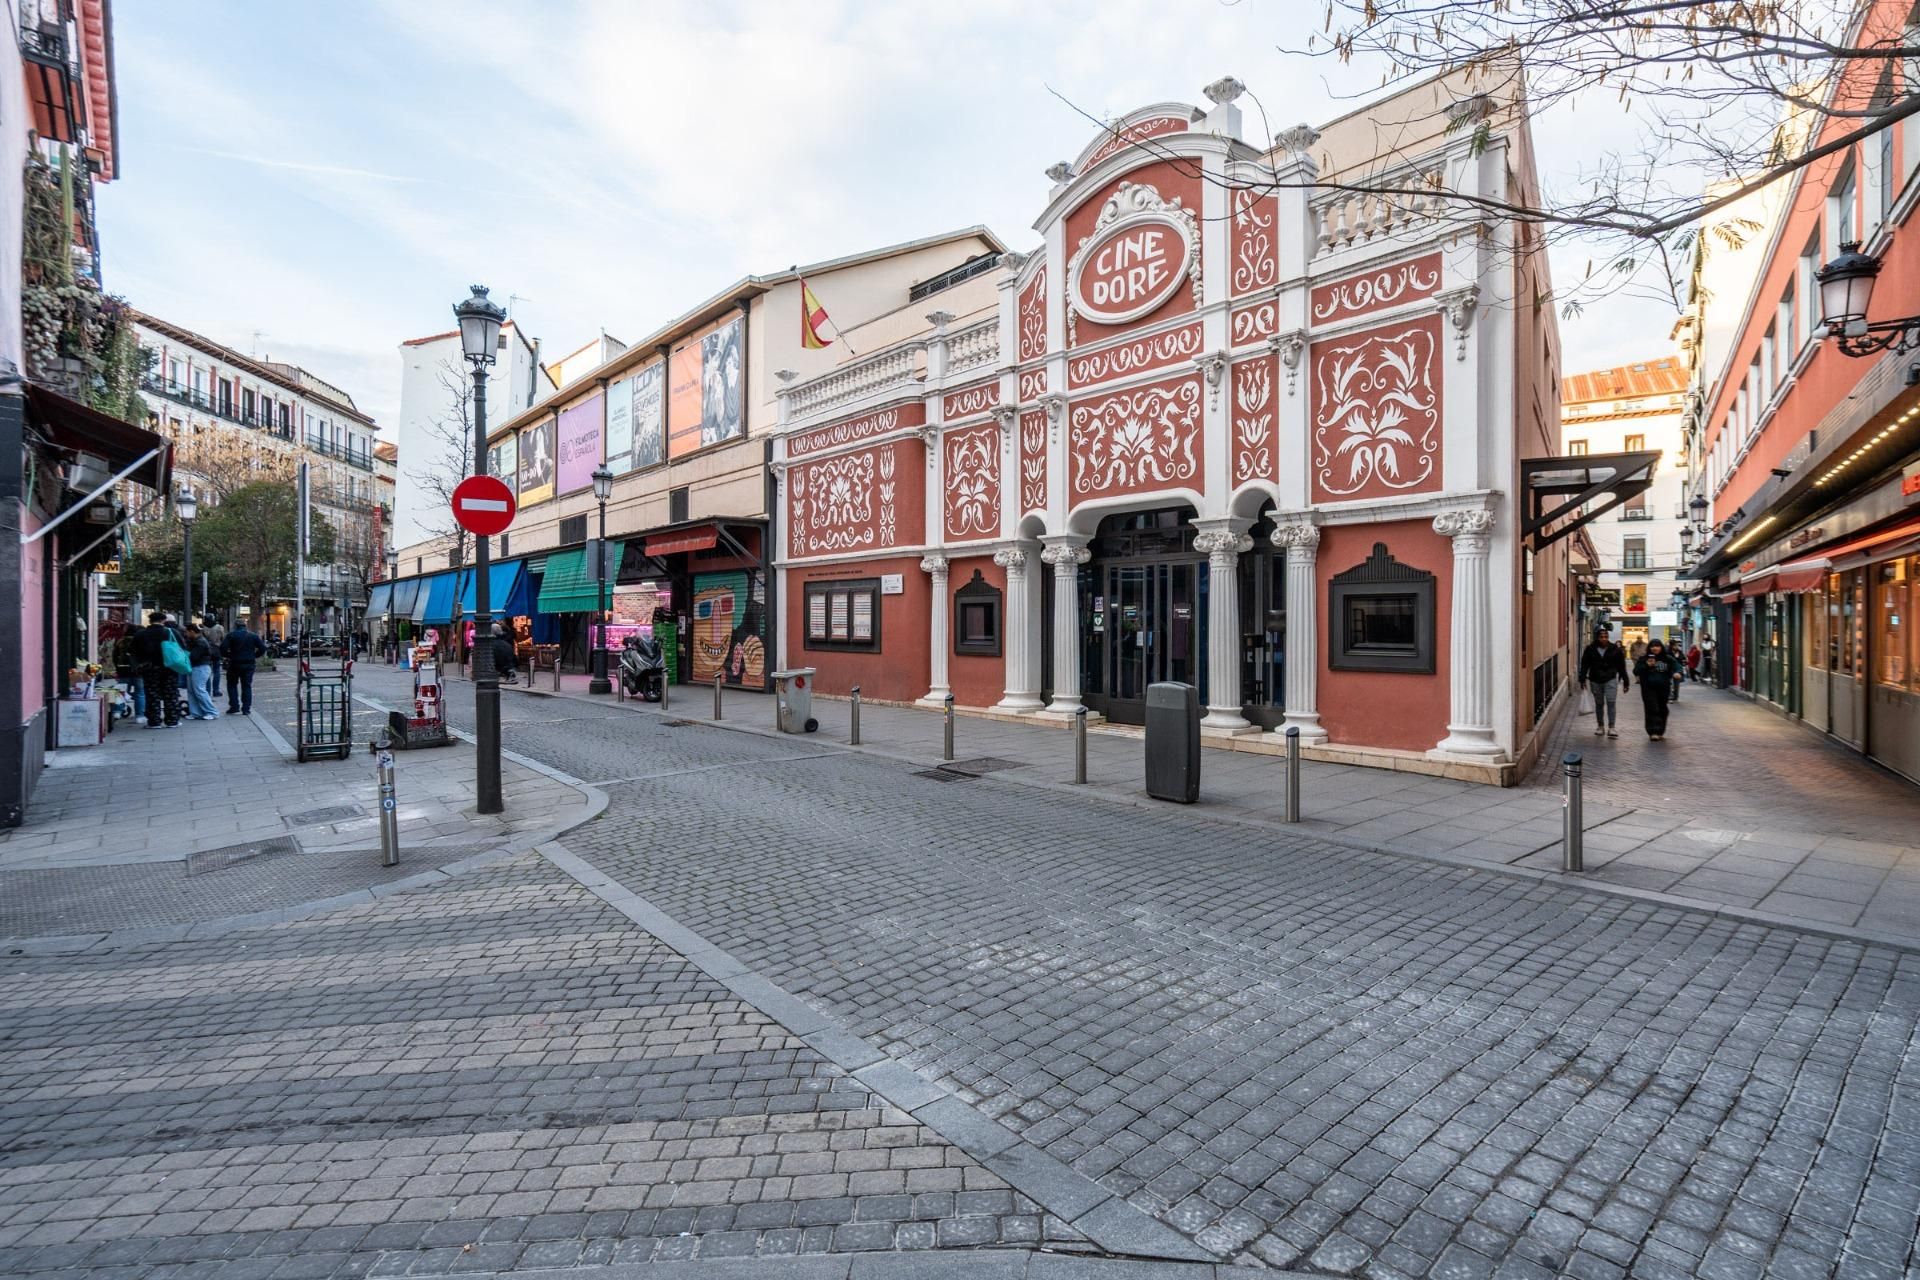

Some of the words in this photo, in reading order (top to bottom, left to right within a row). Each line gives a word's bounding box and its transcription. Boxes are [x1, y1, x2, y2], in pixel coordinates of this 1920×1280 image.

[1096, 231, 1164, 276] CINE
[1093, 258, 1169, 305] DORE
[575, 428, 599, 446] FILMOTECA
[575, 443, 596, 459] ESPAÑOLA
[95, 562, 119, 571] ATM
